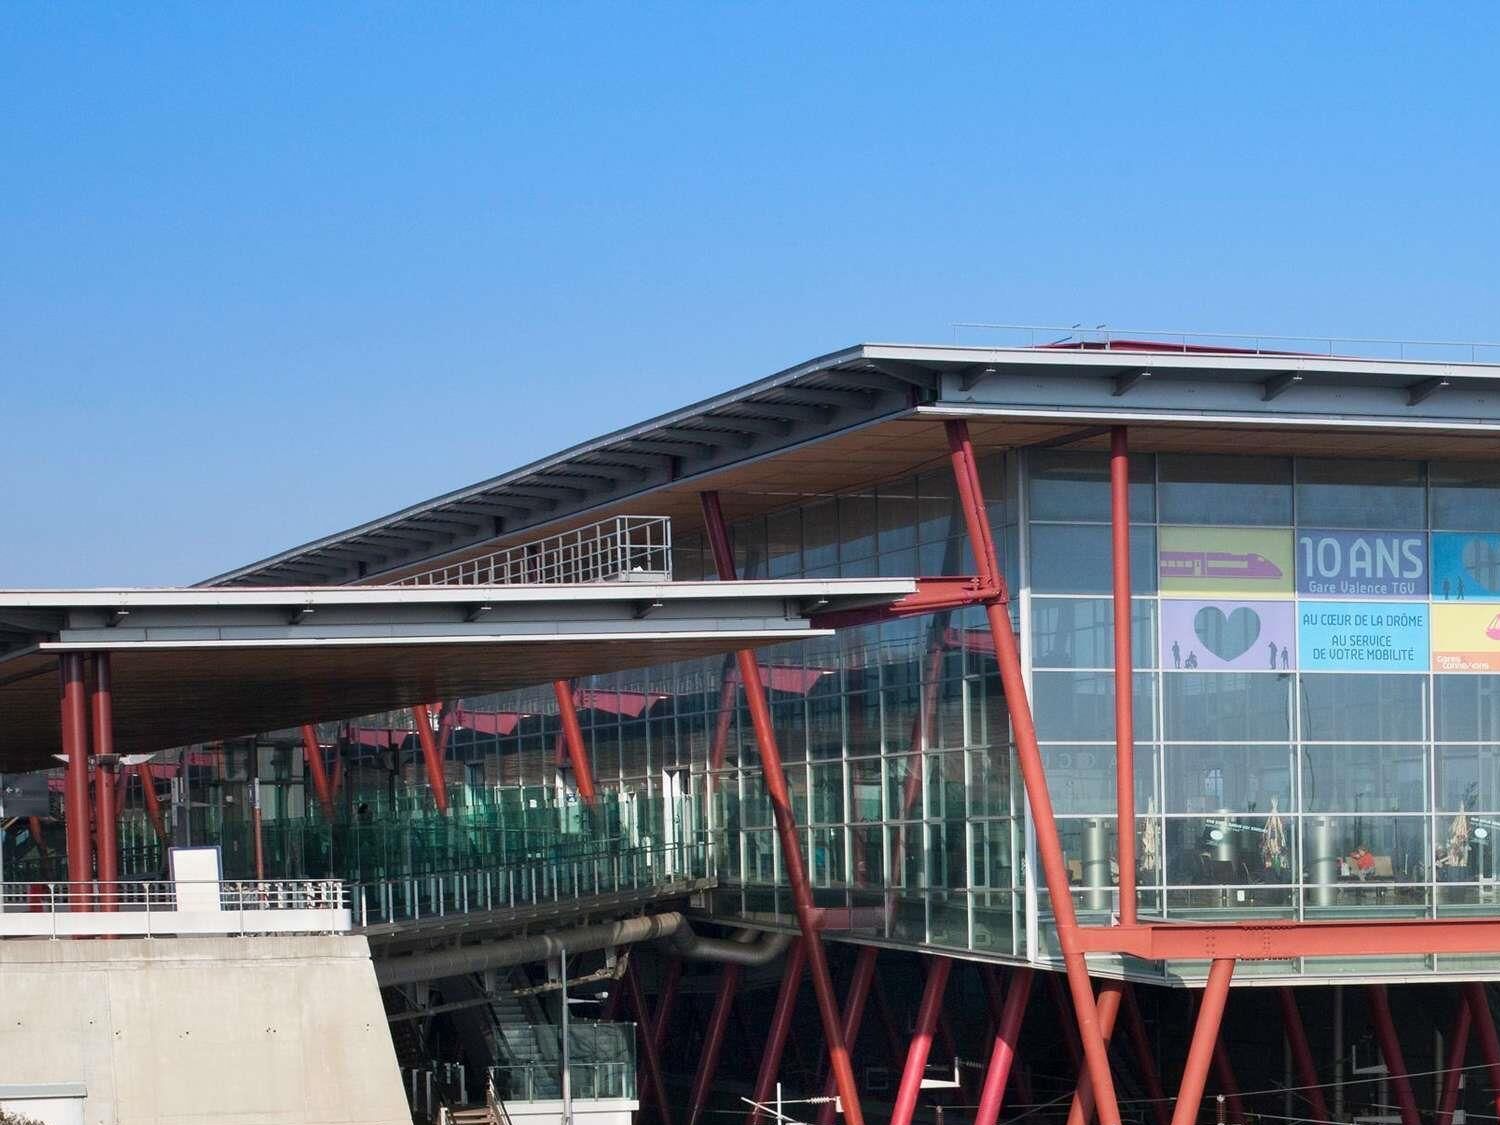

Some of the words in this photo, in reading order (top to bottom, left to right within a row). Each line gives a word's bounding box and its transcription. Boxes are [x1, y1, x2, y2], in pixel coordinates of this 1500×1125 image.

[1300, 536, 1341, 578] 10
[1349, 537, 1424, 579] ANS
[1308, 581, 1337, 593] Gare
[1341, 581, 1388, 594] Valence
[1391, 582, 1416, 594] TGV
[1303, 614, 1318, 626] AU
[1320, 614, 1352, 626] CŒUR
[1354, 615, 1368, 626] DE
[1371, 615, 1384, 627] LA
[1386, 612, 1424, 627] DRÔME
[1331, 635, 1347, 647] AU
[1350, 635, 1392, 647] SERVICE
[1313, 648, 1326, 660] DE
[1329, 648, 1364, 661] VOTRE
[1367, 647, 1416, 661] MOBILITÉ
